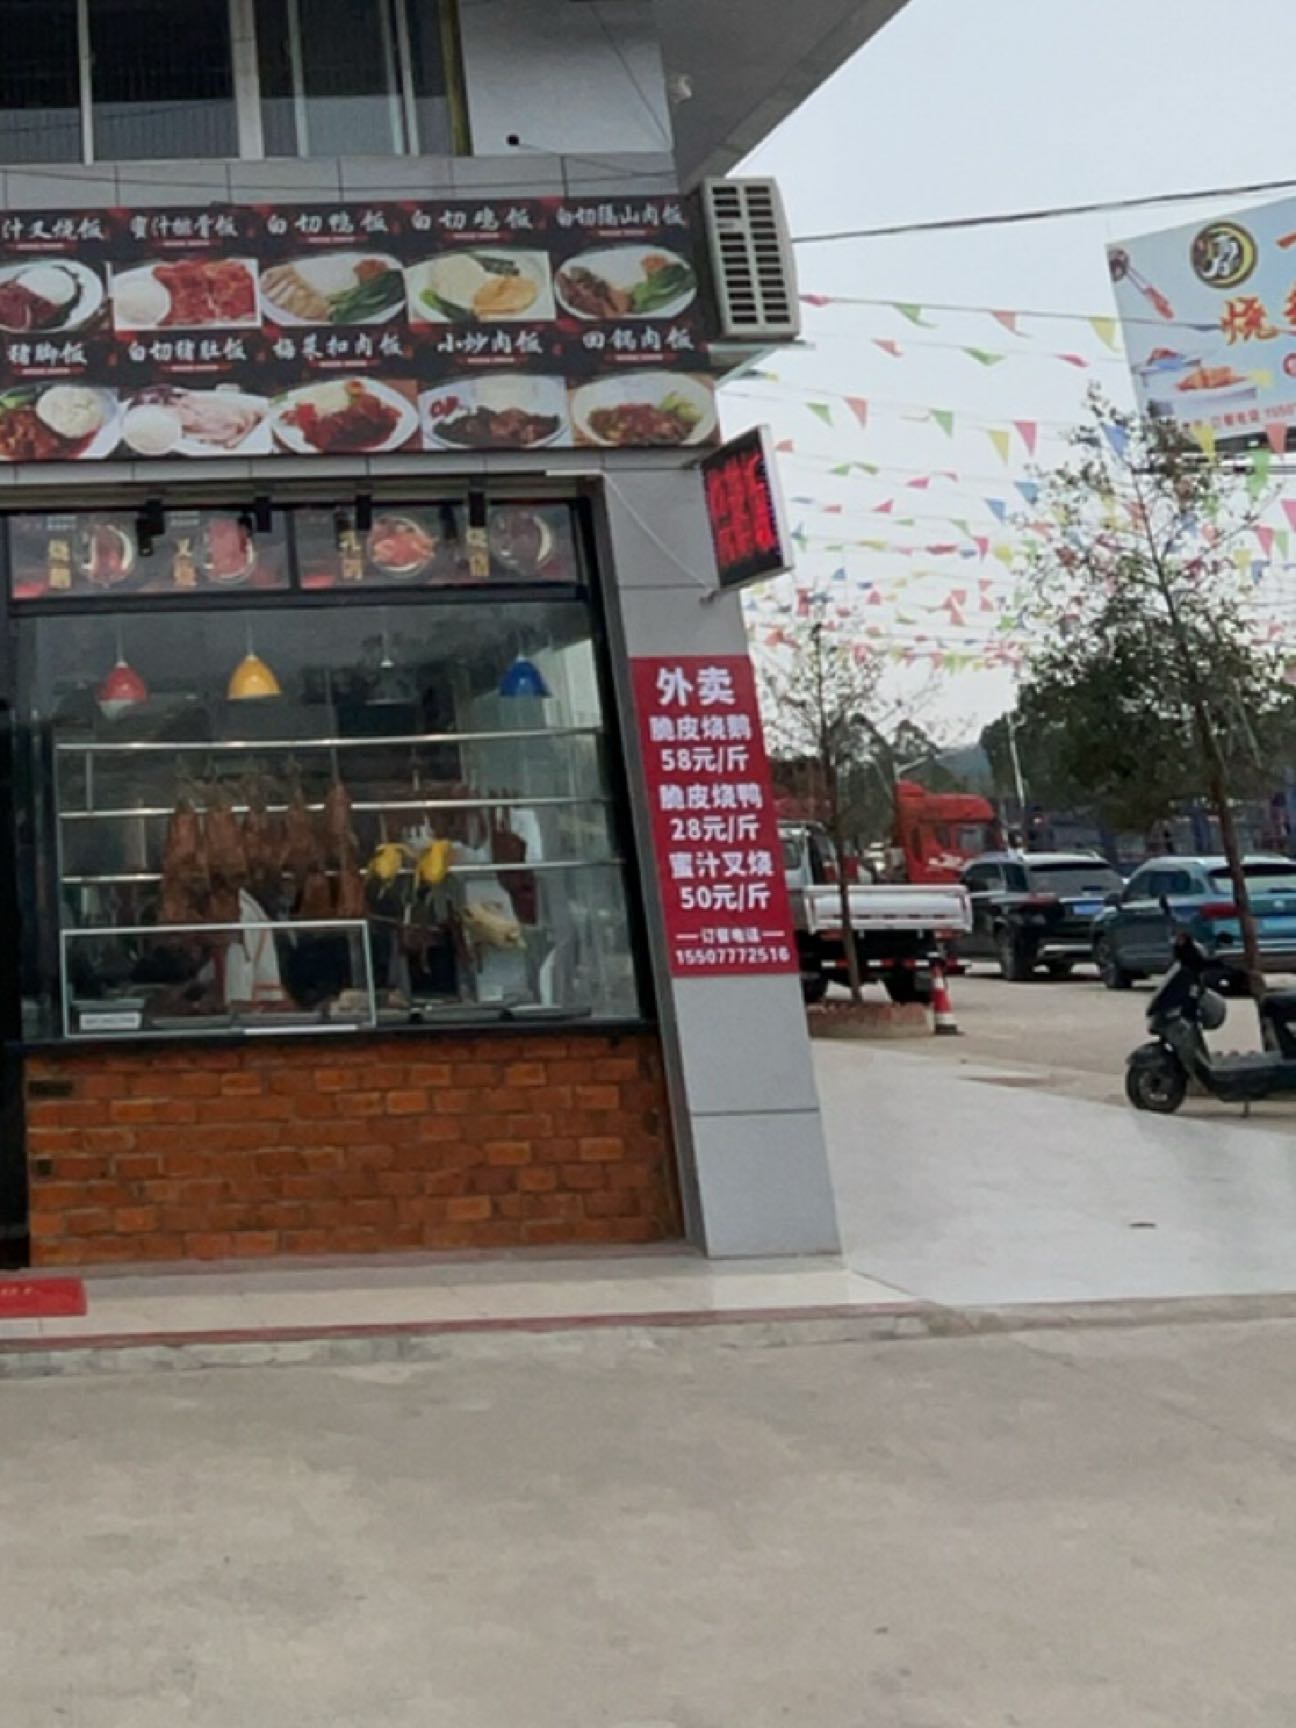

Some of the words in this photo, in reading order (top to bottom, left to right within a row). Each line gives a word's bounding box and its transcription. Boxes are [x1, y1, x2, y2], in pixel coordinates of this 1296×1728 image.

[656, 666, 736, 708] 外卖
[649, 713, 752, 743] 脆皮烧鹅
[661, 747, 750, 774] 58元/斤
[660, 782, 764, 812] 脆皮烧鸭
[671, 816, 761, 844] 28元/斤
[669, 849, 775, 880] 蜜汁叉烧
[680, 883, 771, 913] 50元/斤
